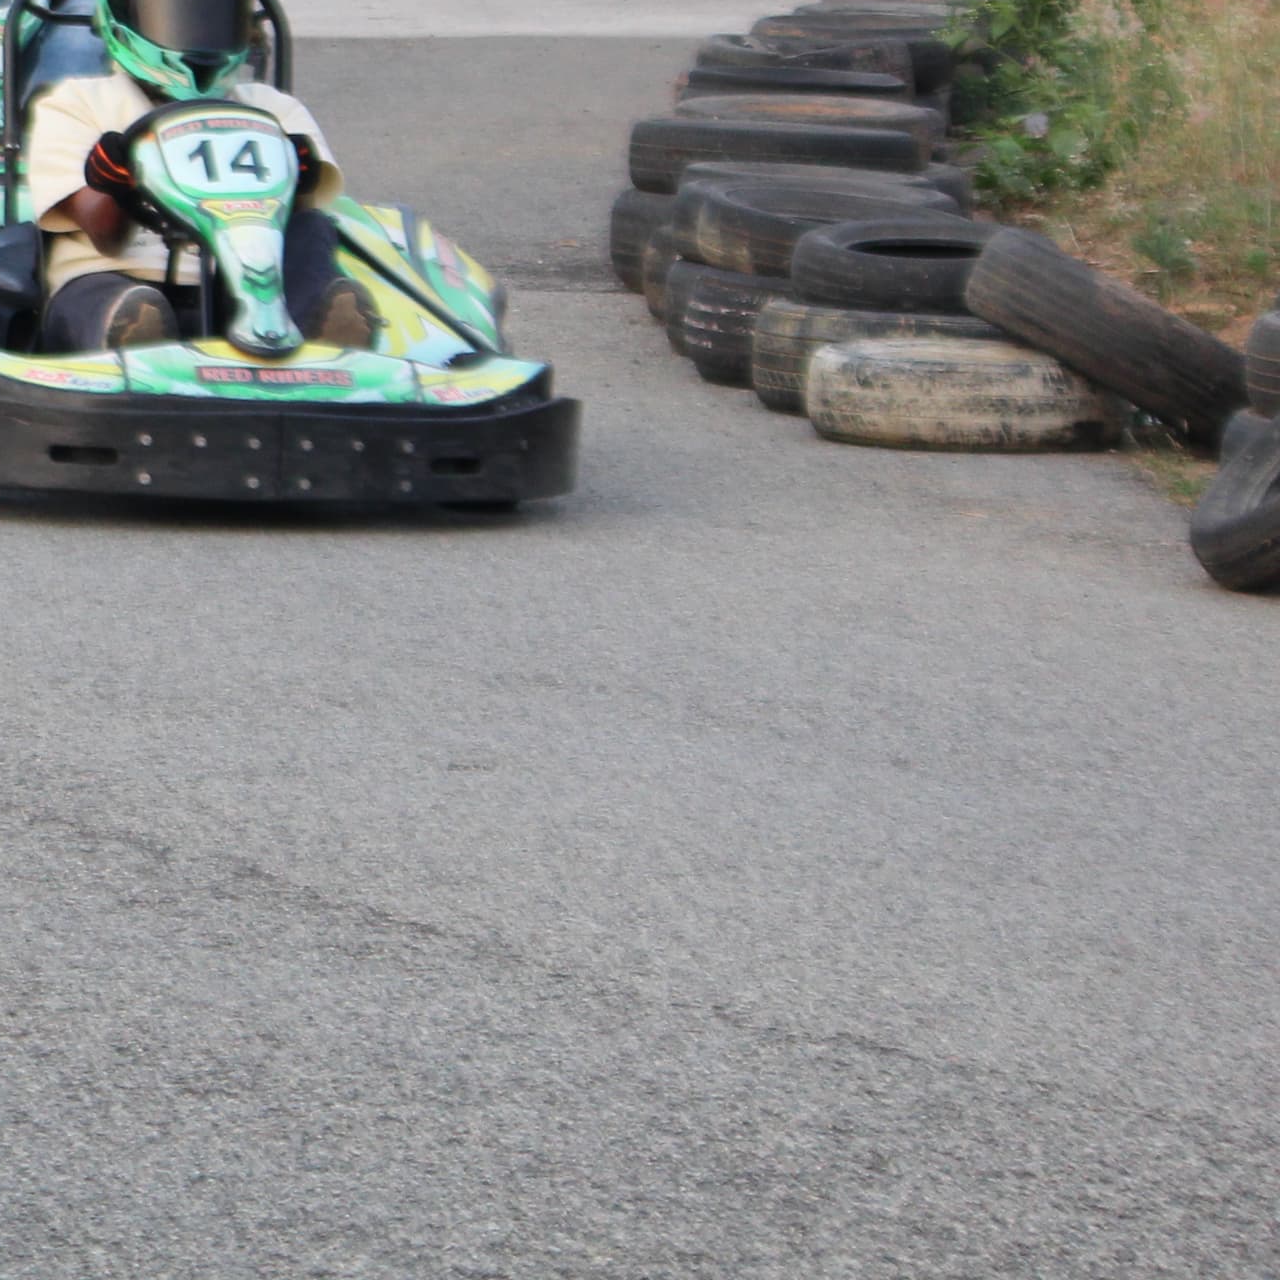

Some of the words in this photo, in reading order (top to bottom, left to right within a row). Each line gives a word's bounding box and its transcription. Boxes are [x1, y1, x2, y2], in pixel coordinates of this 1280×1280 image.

[188, 139, 271, 183] 14
[201, 368, 253, 382] RED
[257, 369, 353, 387] RIDERS
